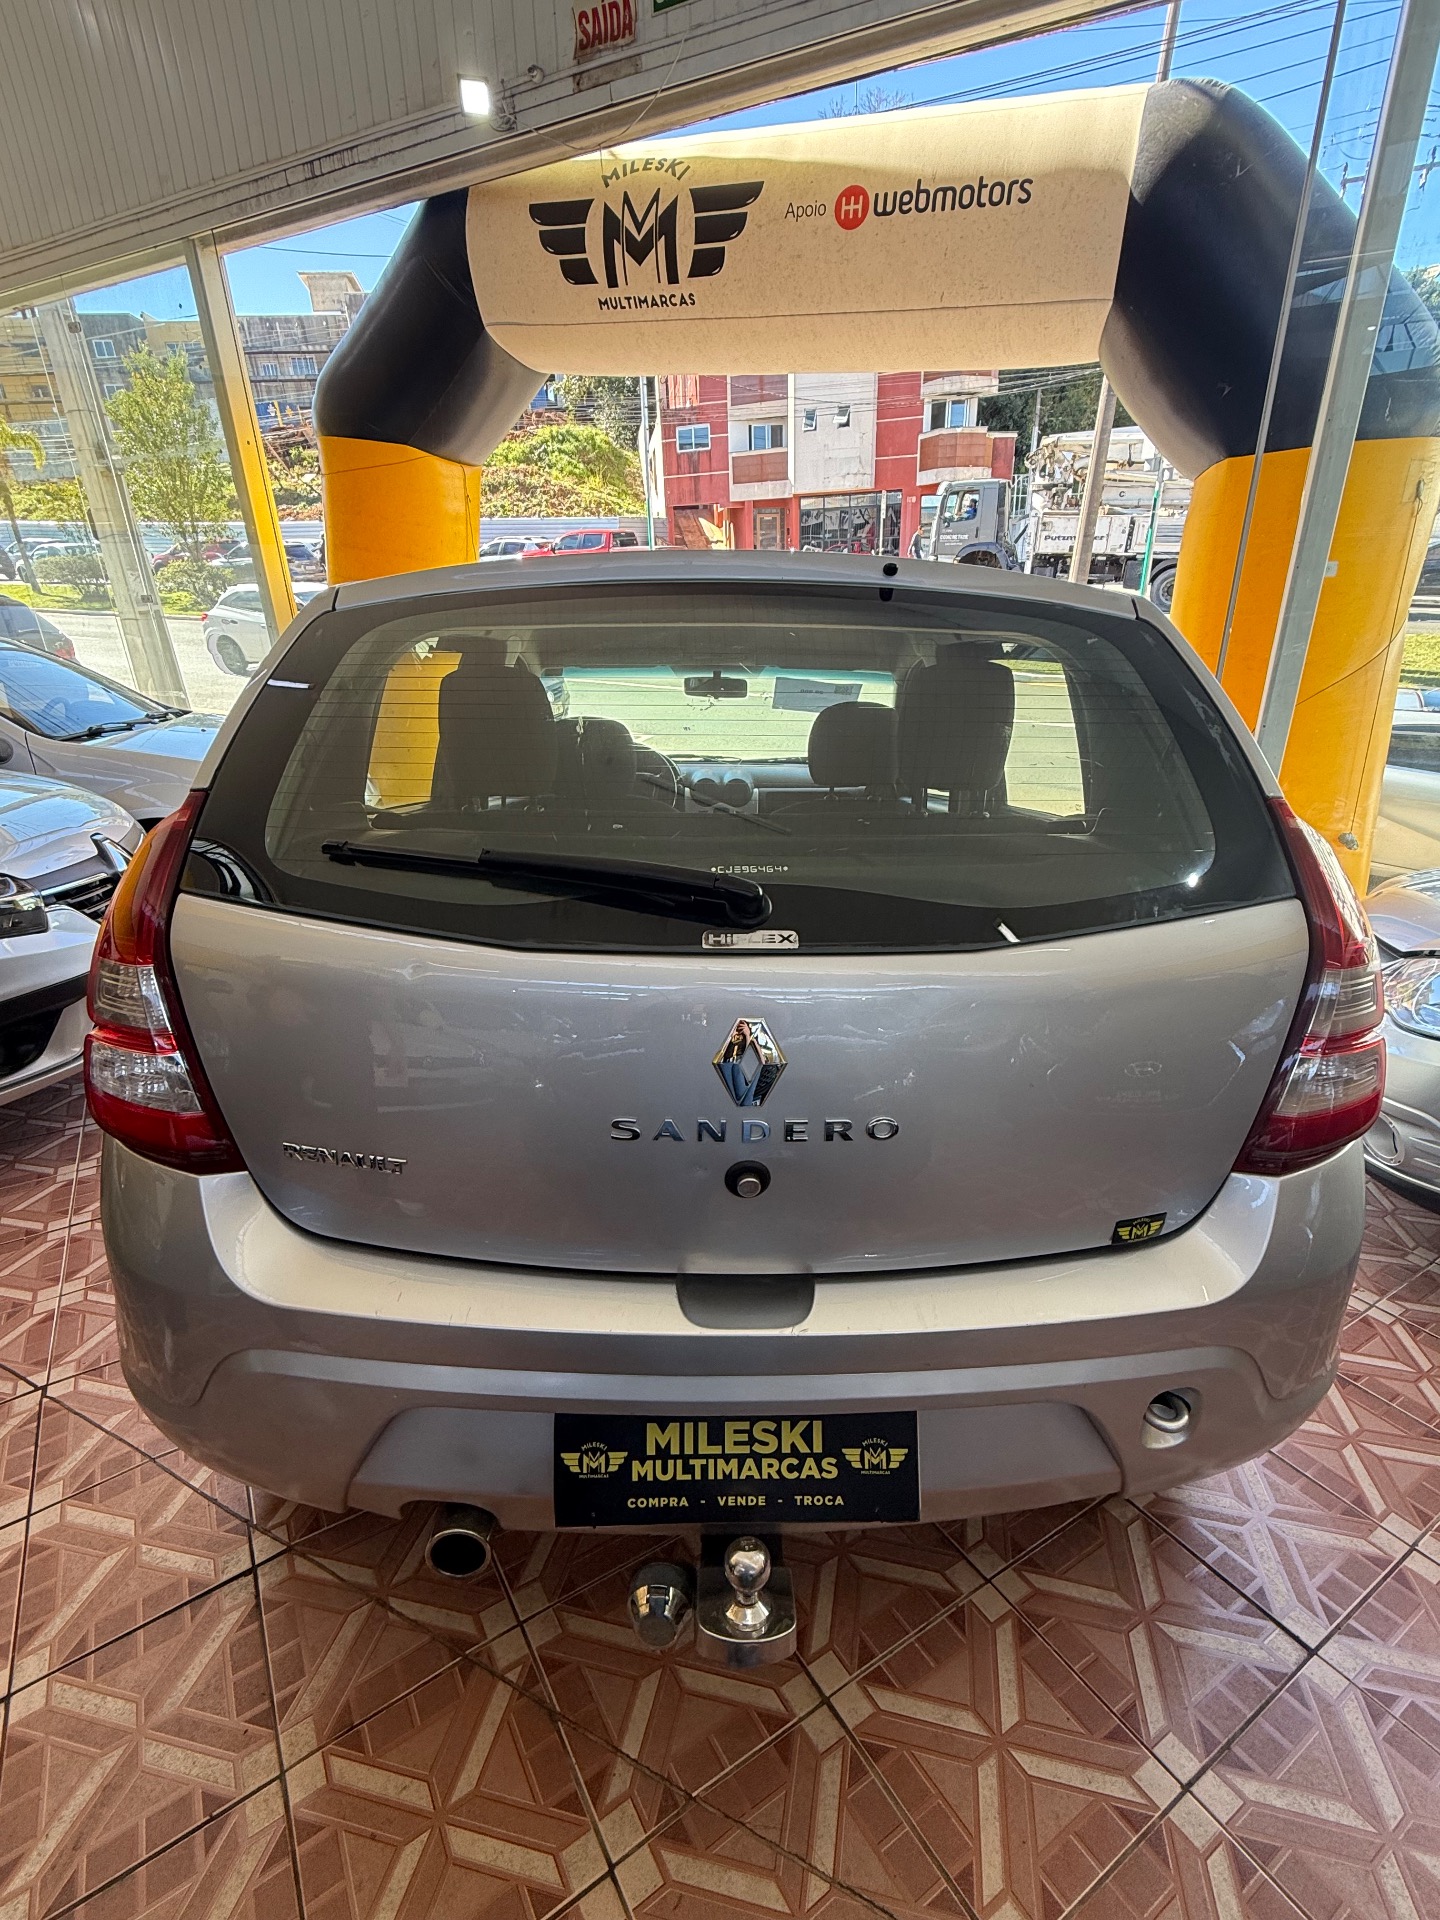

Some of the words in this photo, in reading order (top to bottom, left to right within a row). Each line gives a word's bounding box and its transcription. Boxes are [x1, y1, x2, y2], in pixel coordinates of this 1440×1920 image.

[601, 157, 691, 188] MILESKI
[784, 200, 827, 222] Apoio
[873, 176, 1034, 217] webmotors
[597, 292, 696, 310] MULTIMARCAS
[610, 1116, 899, 1142] SANDERO
[282, 1142, 407, 1175] RENAULT
[646, 1420, 823, 1455] MILESKI
[631, 1457, 839, 1482] MULTIMARCAS
[627, 1497, 689, 1508] COMPRA
[717, 1495, 767, 1507] VENDE
[795, 1495, 845, 1506] TROCA
